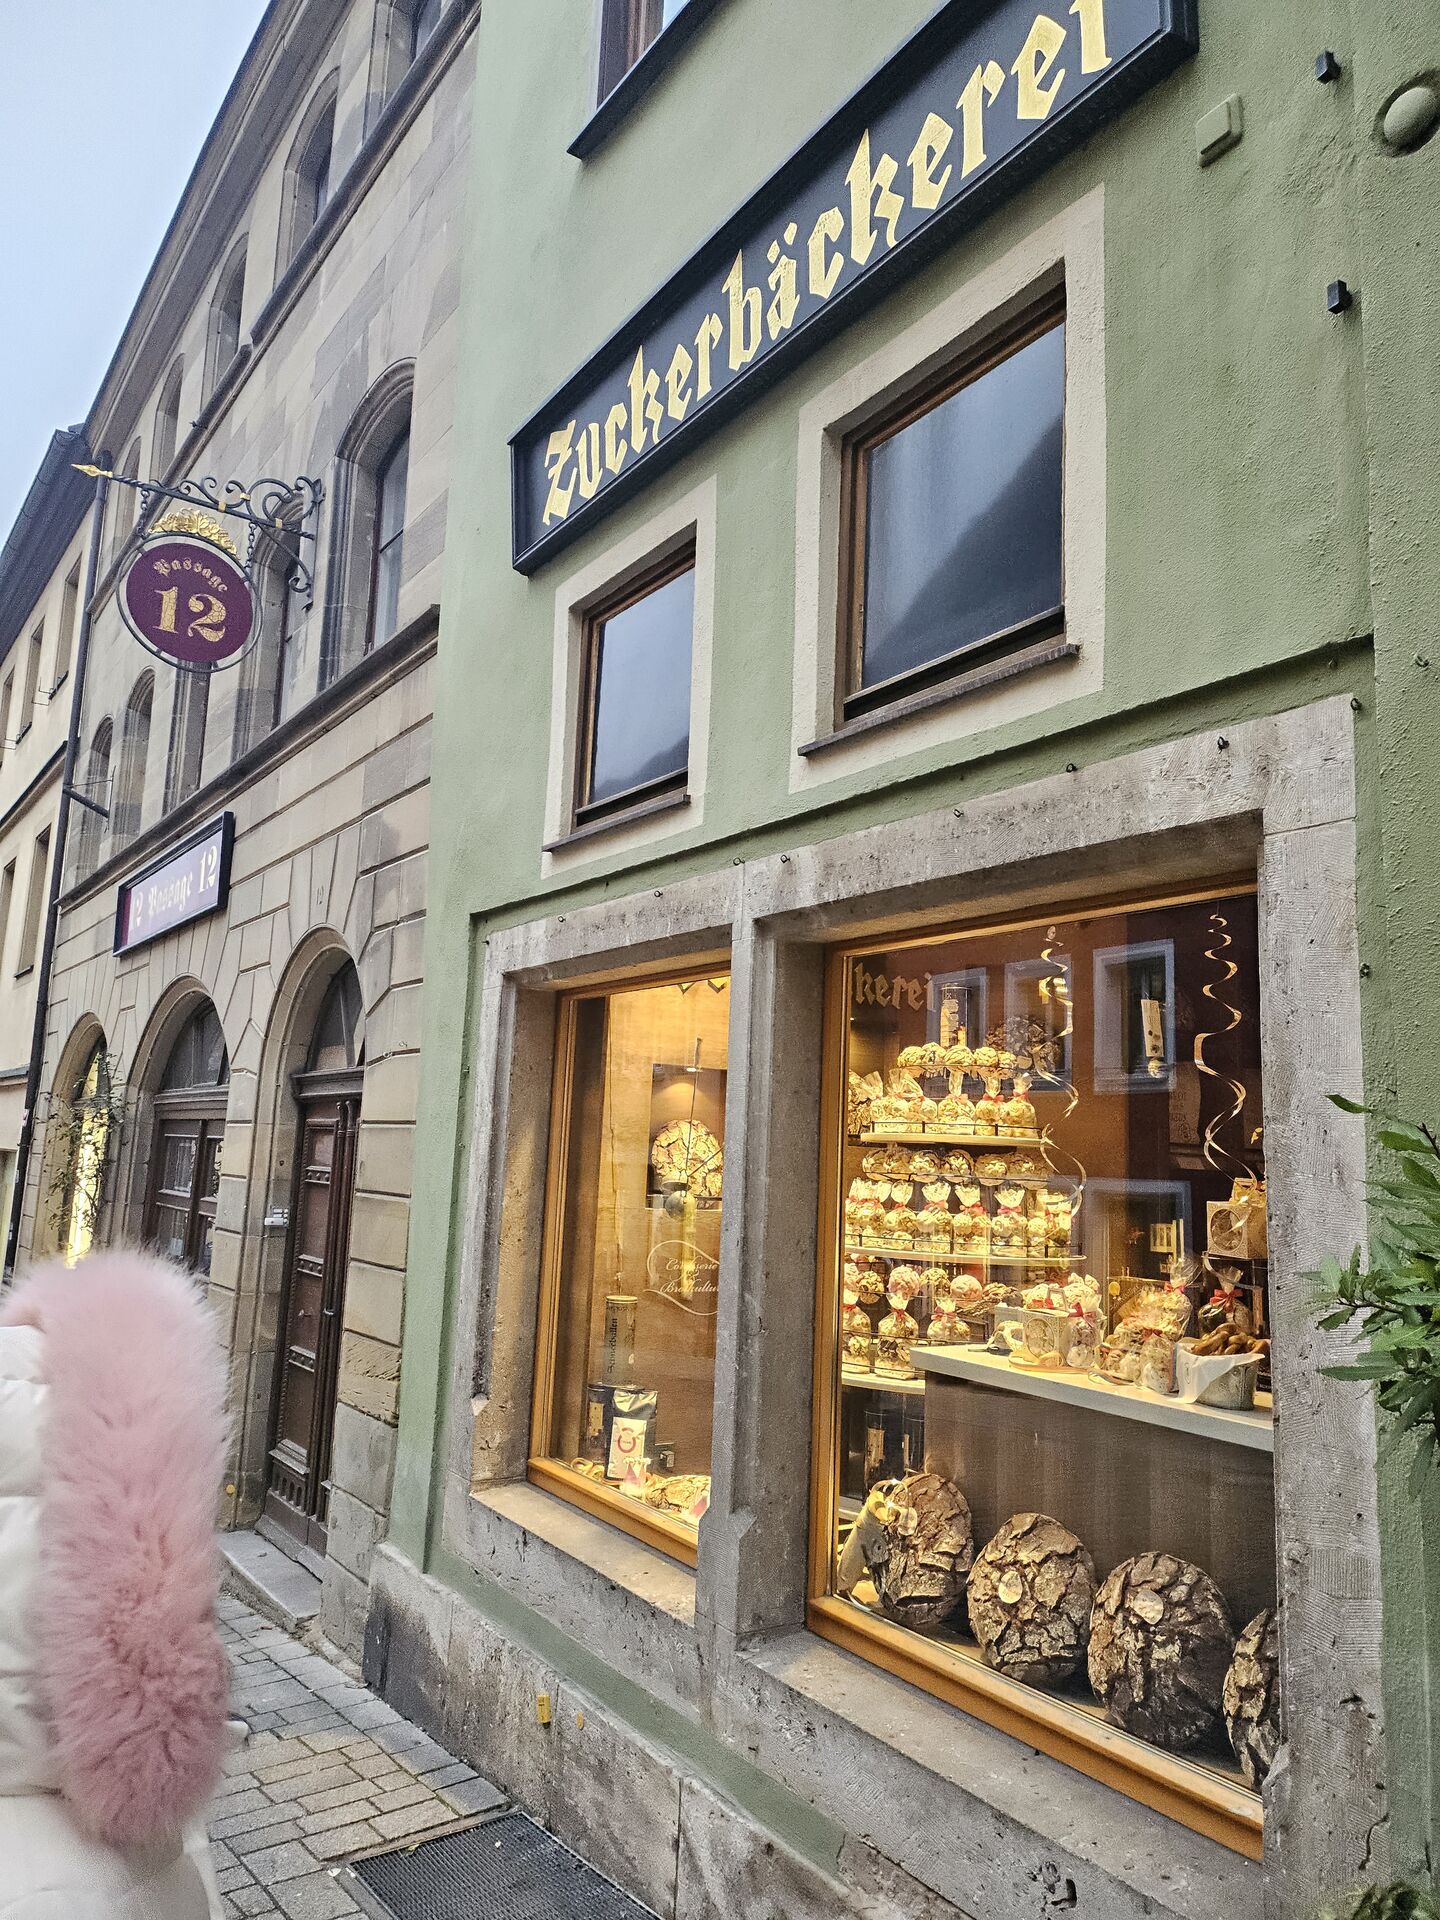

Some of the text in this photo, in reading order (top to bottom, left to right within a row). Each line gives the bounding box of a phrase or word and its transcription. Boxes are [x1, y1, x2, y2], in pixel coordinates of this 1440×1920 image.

[542, 0, 1113, 525] Zuckerbäckerei
[153, 557, 228, 592] Passage
[152, 586, 227, 642] 12
[198, 845, 219, 895] 12
